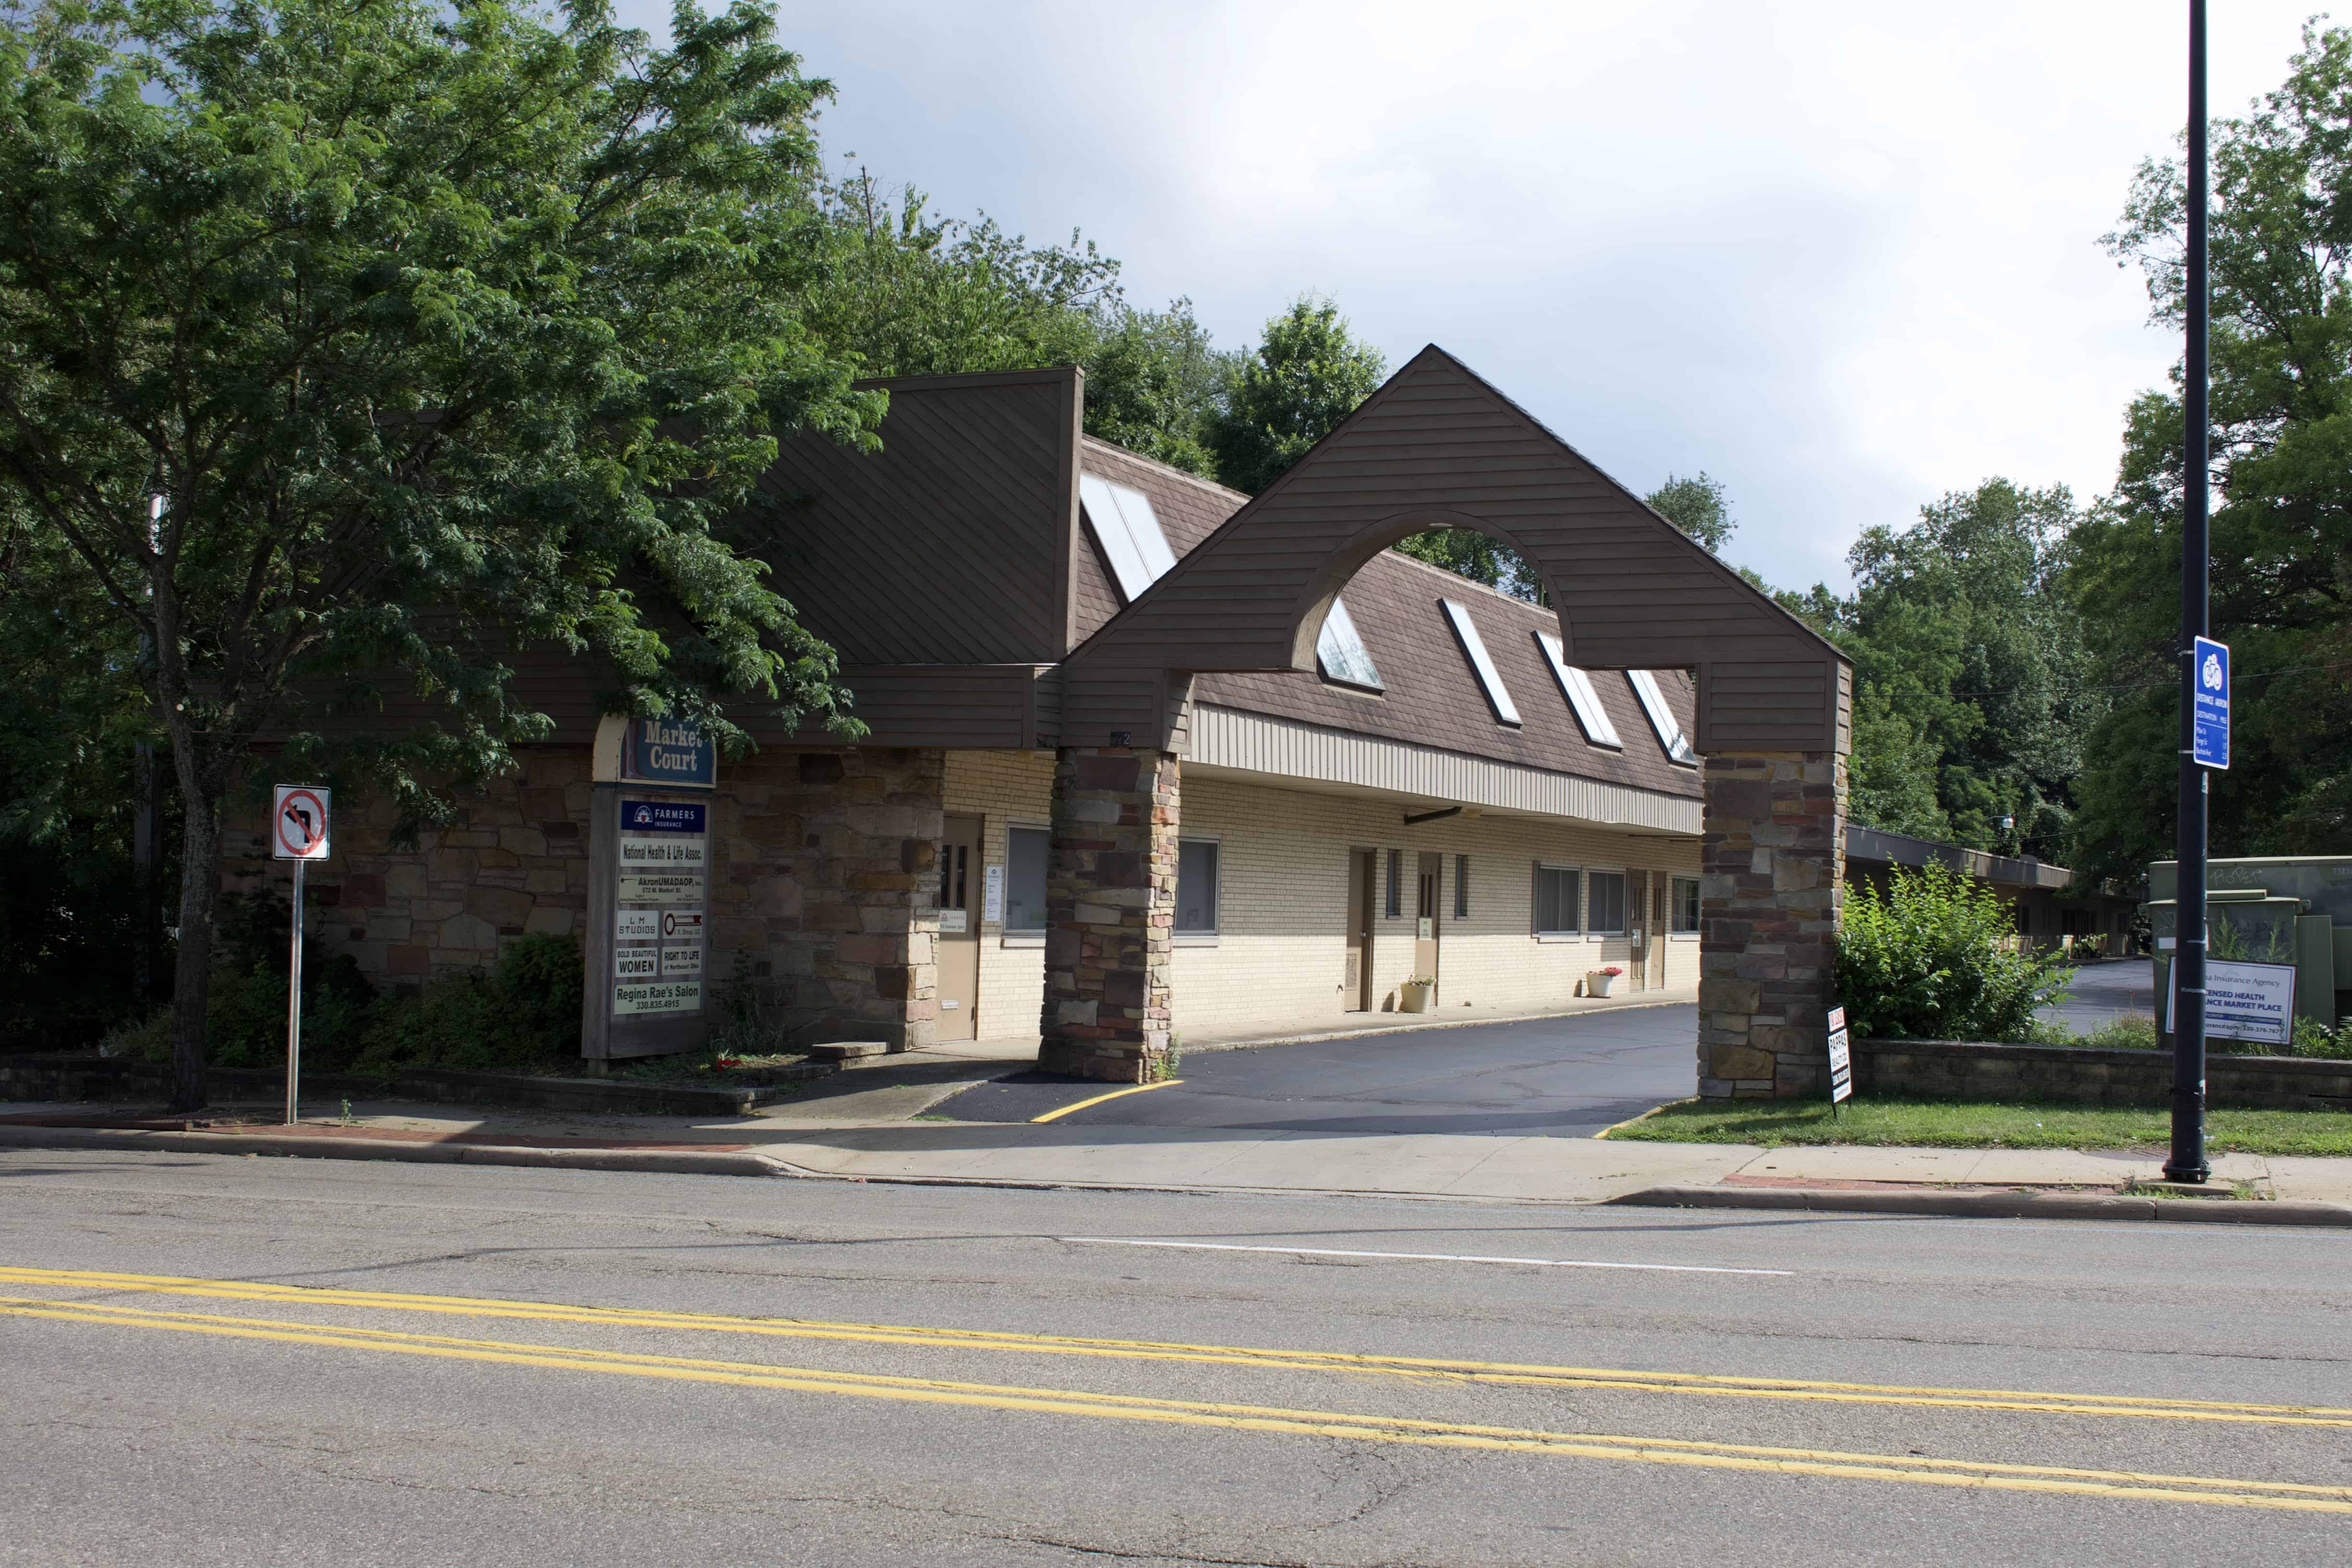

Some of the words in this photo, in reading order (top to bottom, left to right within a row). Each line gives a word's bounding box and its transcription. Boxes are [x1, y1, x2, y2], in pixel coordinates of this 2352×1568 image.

[645, 720, 703, 748] Market
[651, 745, 697, 771] Court
[655, 809, 695, 819] FARMERS
[624, 844, 646, 859] National
[648, 845, 665, 860] Health
[667, 845, 671, 860] &
[673, 845, 683, 860] Life
[685, 846, 702, 860] Assoc.
[665, 951, 679, 961] RIGHT
[681, 951, 687, 960] TO
[689, 951, 699, 960] LIFE
[619, 960, 654, 973] WOMEN
[2214, 975, 2250, 984] Insurance
[2253, 979, 2280, 989] Agency
[617, 988, 646, 1002] Regina
[650, 986, 672, 998] Rae's
[676, 985, 698, 997] Salon
[2234, 992, 2265, 1000] HEALTH
[636, 1000, 680, 1009] 330.835.4915
[2224, 1000, 2256, 1009] MARKET
[2257, 1003, 2282, 1011] PLACE
